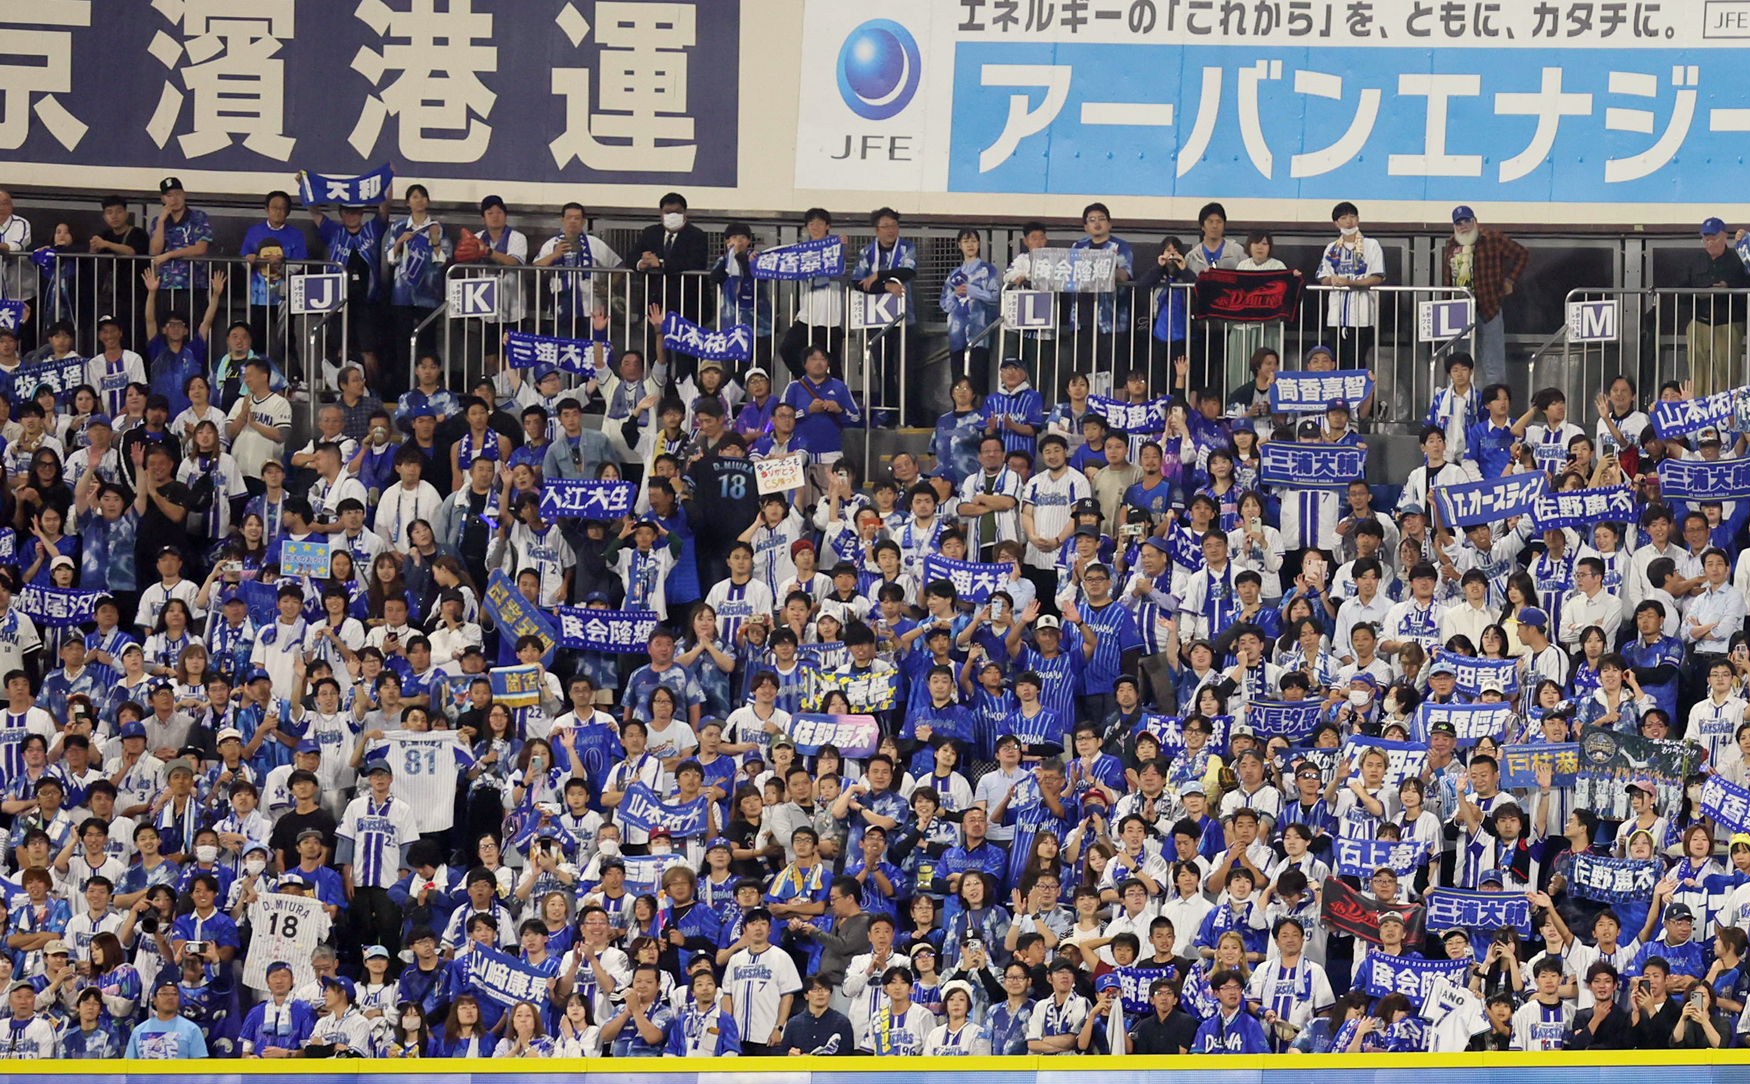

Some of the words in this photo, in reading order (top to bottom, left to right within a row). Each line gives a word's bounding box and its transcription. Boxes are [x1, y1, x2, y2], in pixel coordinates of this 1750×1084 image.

[1714, 12, 1748, 29] JFE
[831, 135, 914, 162] JFE
[327, 174, 382, 202] 大和
[756, 243, 842, 273] 筒香嘉智
[310, 279, 333, 309] J
[465, 283, 491, 313] K
[867, 293, 895, 323] K
[1024, 295, 1046, 324] L
[1440, 306, 1462, 336] L
[1582, 306, 1612, 337] M
[666, 315, 750, 355] 山本祐大
[509, 338, 612, 374] 三浦大輔
[1275, 377, 1366, 402] 筒香嘉智
[1657, 386, 1735, 430] 山本祐
[1268, 449, 1360, 477] 三浦大輔
[540, 486, 630, 511] 入江大生
[718, 473, 747, 500] 18
[1533, 488, 1634, 522] 佐野恵太
[561, 615, 658, 645] 度会隆輝
[793, 719, 876, 749] 佐野恵太
[405, 749, 436, 776] 81
[627, 793, 703, 832] 山本祐大
[263, 899, 311, 921] D.MIURA
[1433, 895, 1528, 928] 三浦大輔
[270, 912, 299, 939] 18
[758, 981, 767, 992] 7
